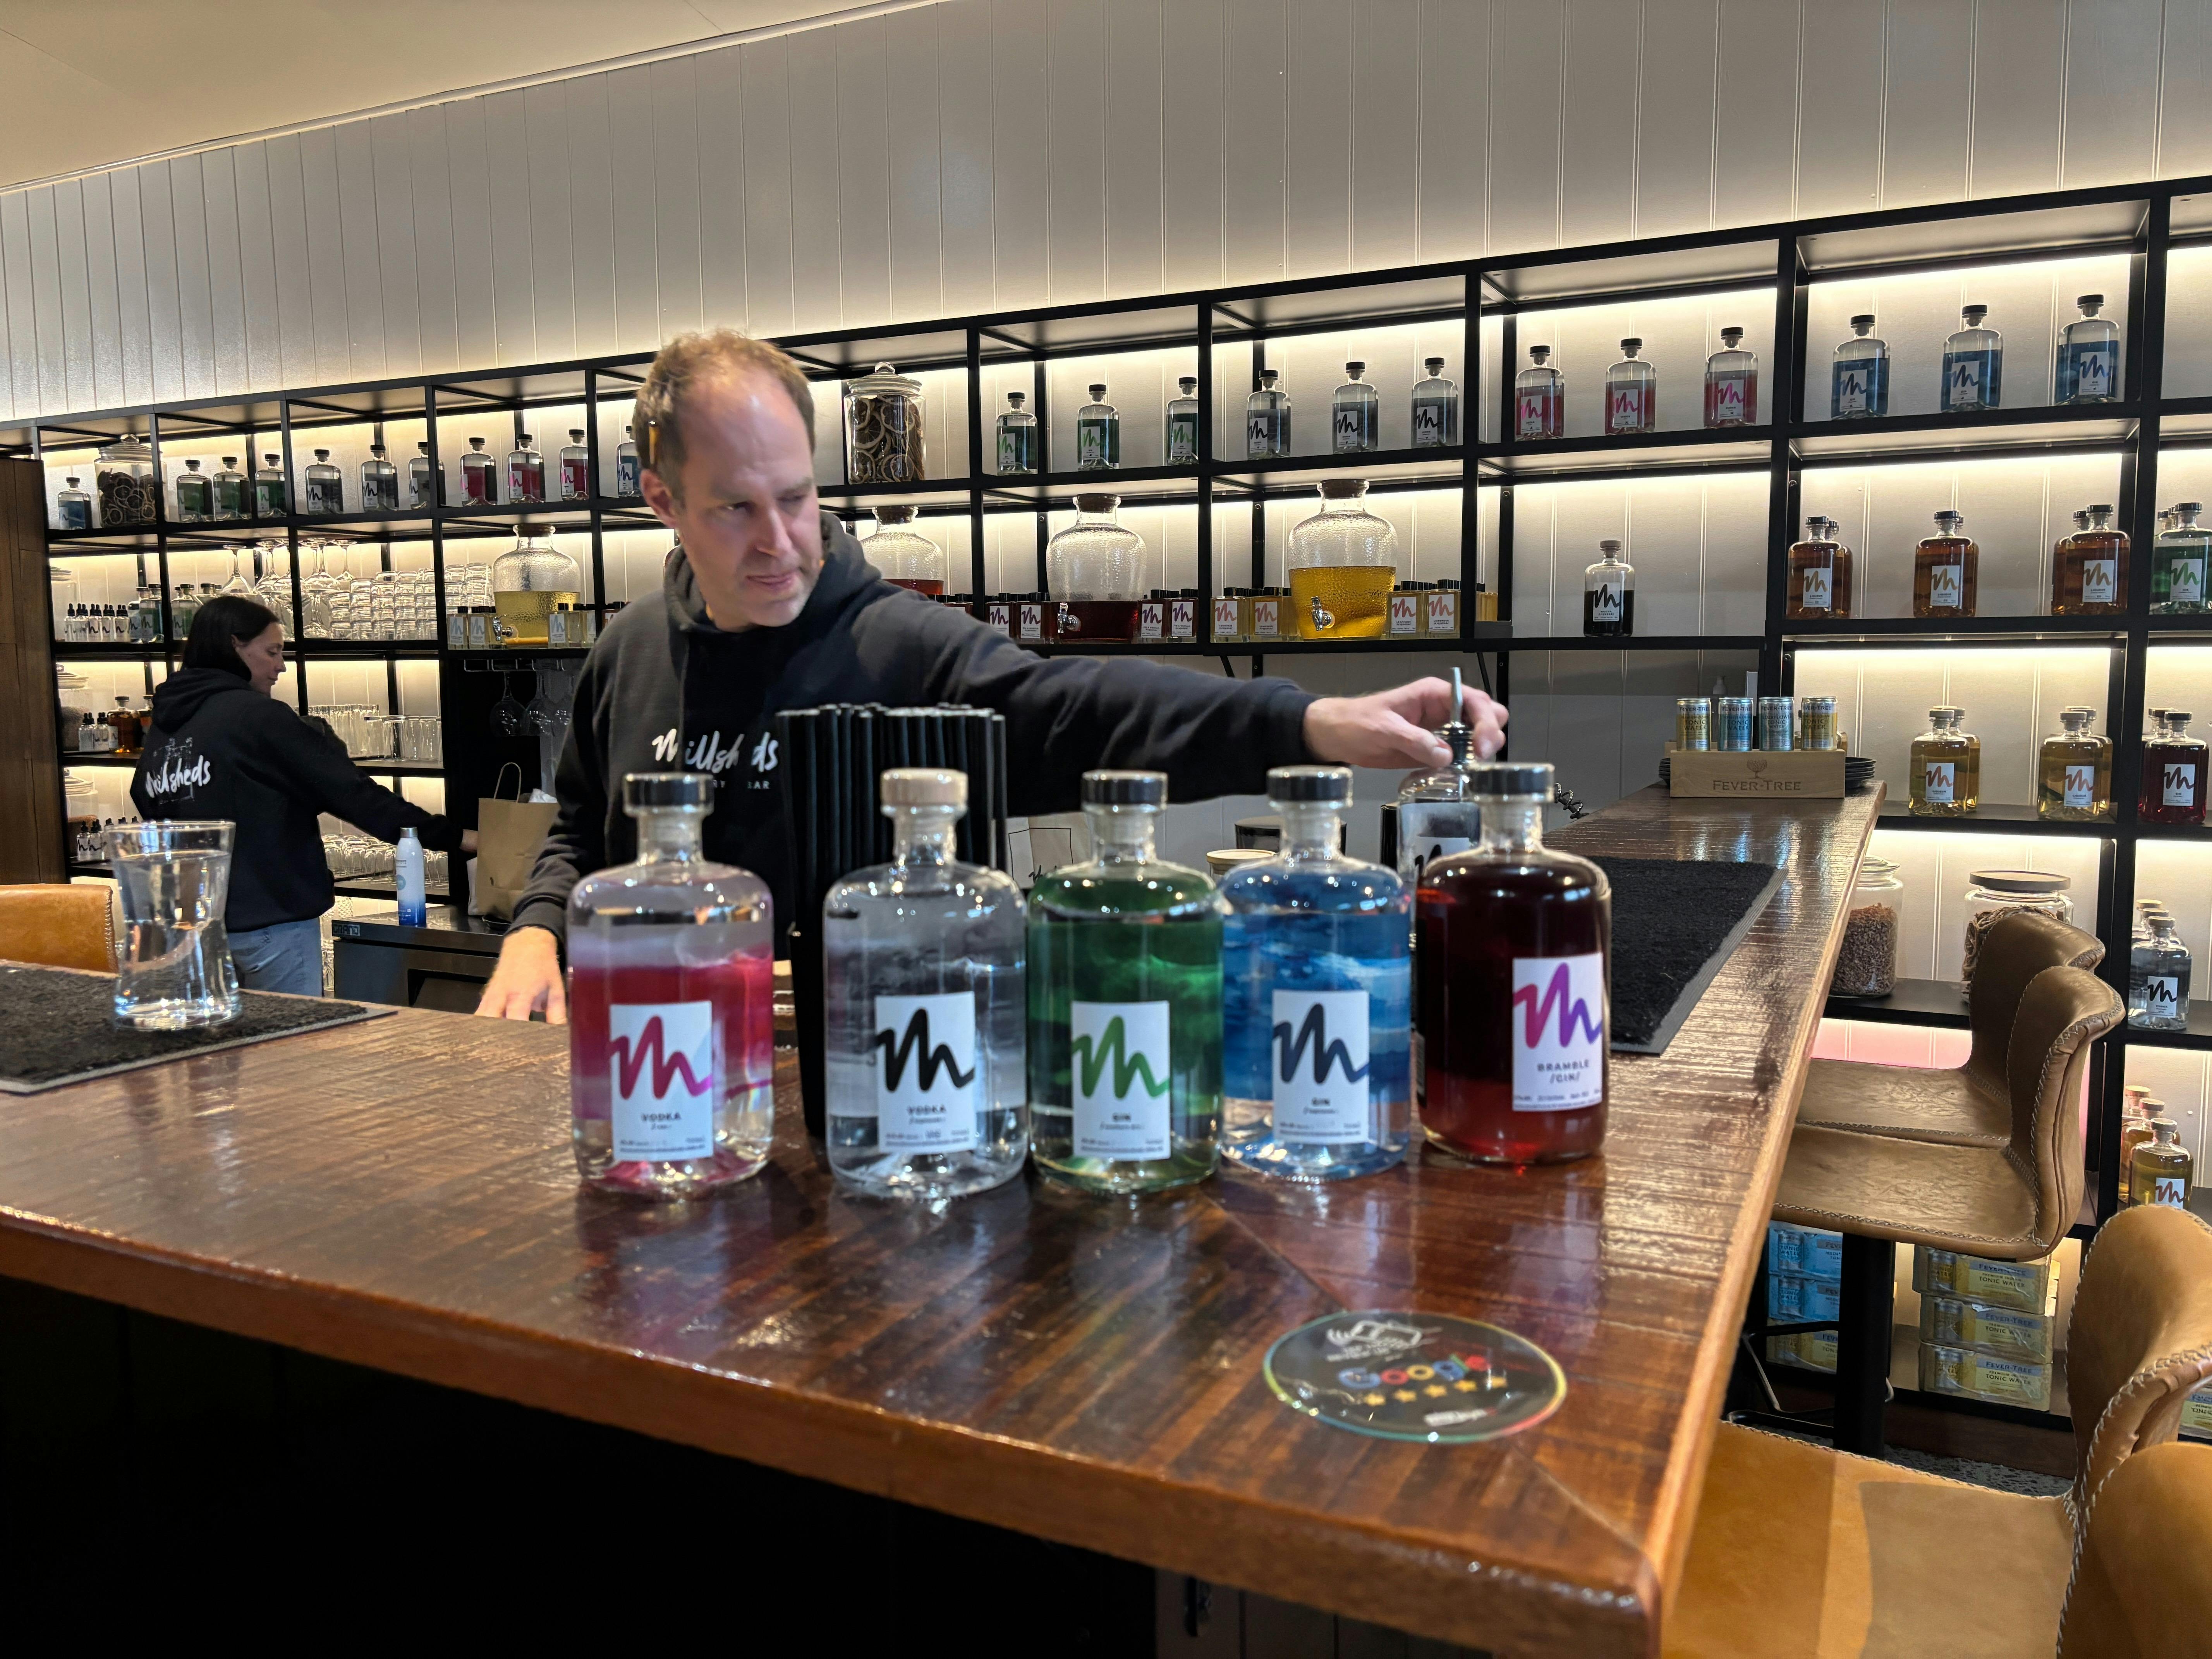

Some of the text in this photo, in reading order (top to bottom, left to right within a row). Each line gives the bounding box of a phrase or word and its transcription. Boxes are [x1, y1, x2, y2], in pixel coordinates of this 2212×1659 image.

[652, 728, 779, 774] Millshds
[1713, 780, 1801, 790] FEVER-TREE
[1537, 1060, 1589, 1072] BRAMBLE
[1312, 1097, 1330, 1106] GIN
[907, 1104, 946, 1115] VODKA
[641, 1112, 682, 1121] VODKA
[1113, 1113, 1131, 1121] GIN
[1985, 1326, 2006, 1334] TONIC
[1338, 1353, 1490, 1389] Google
[1986, 1361, 2032, 1374] FEVER-TREE
